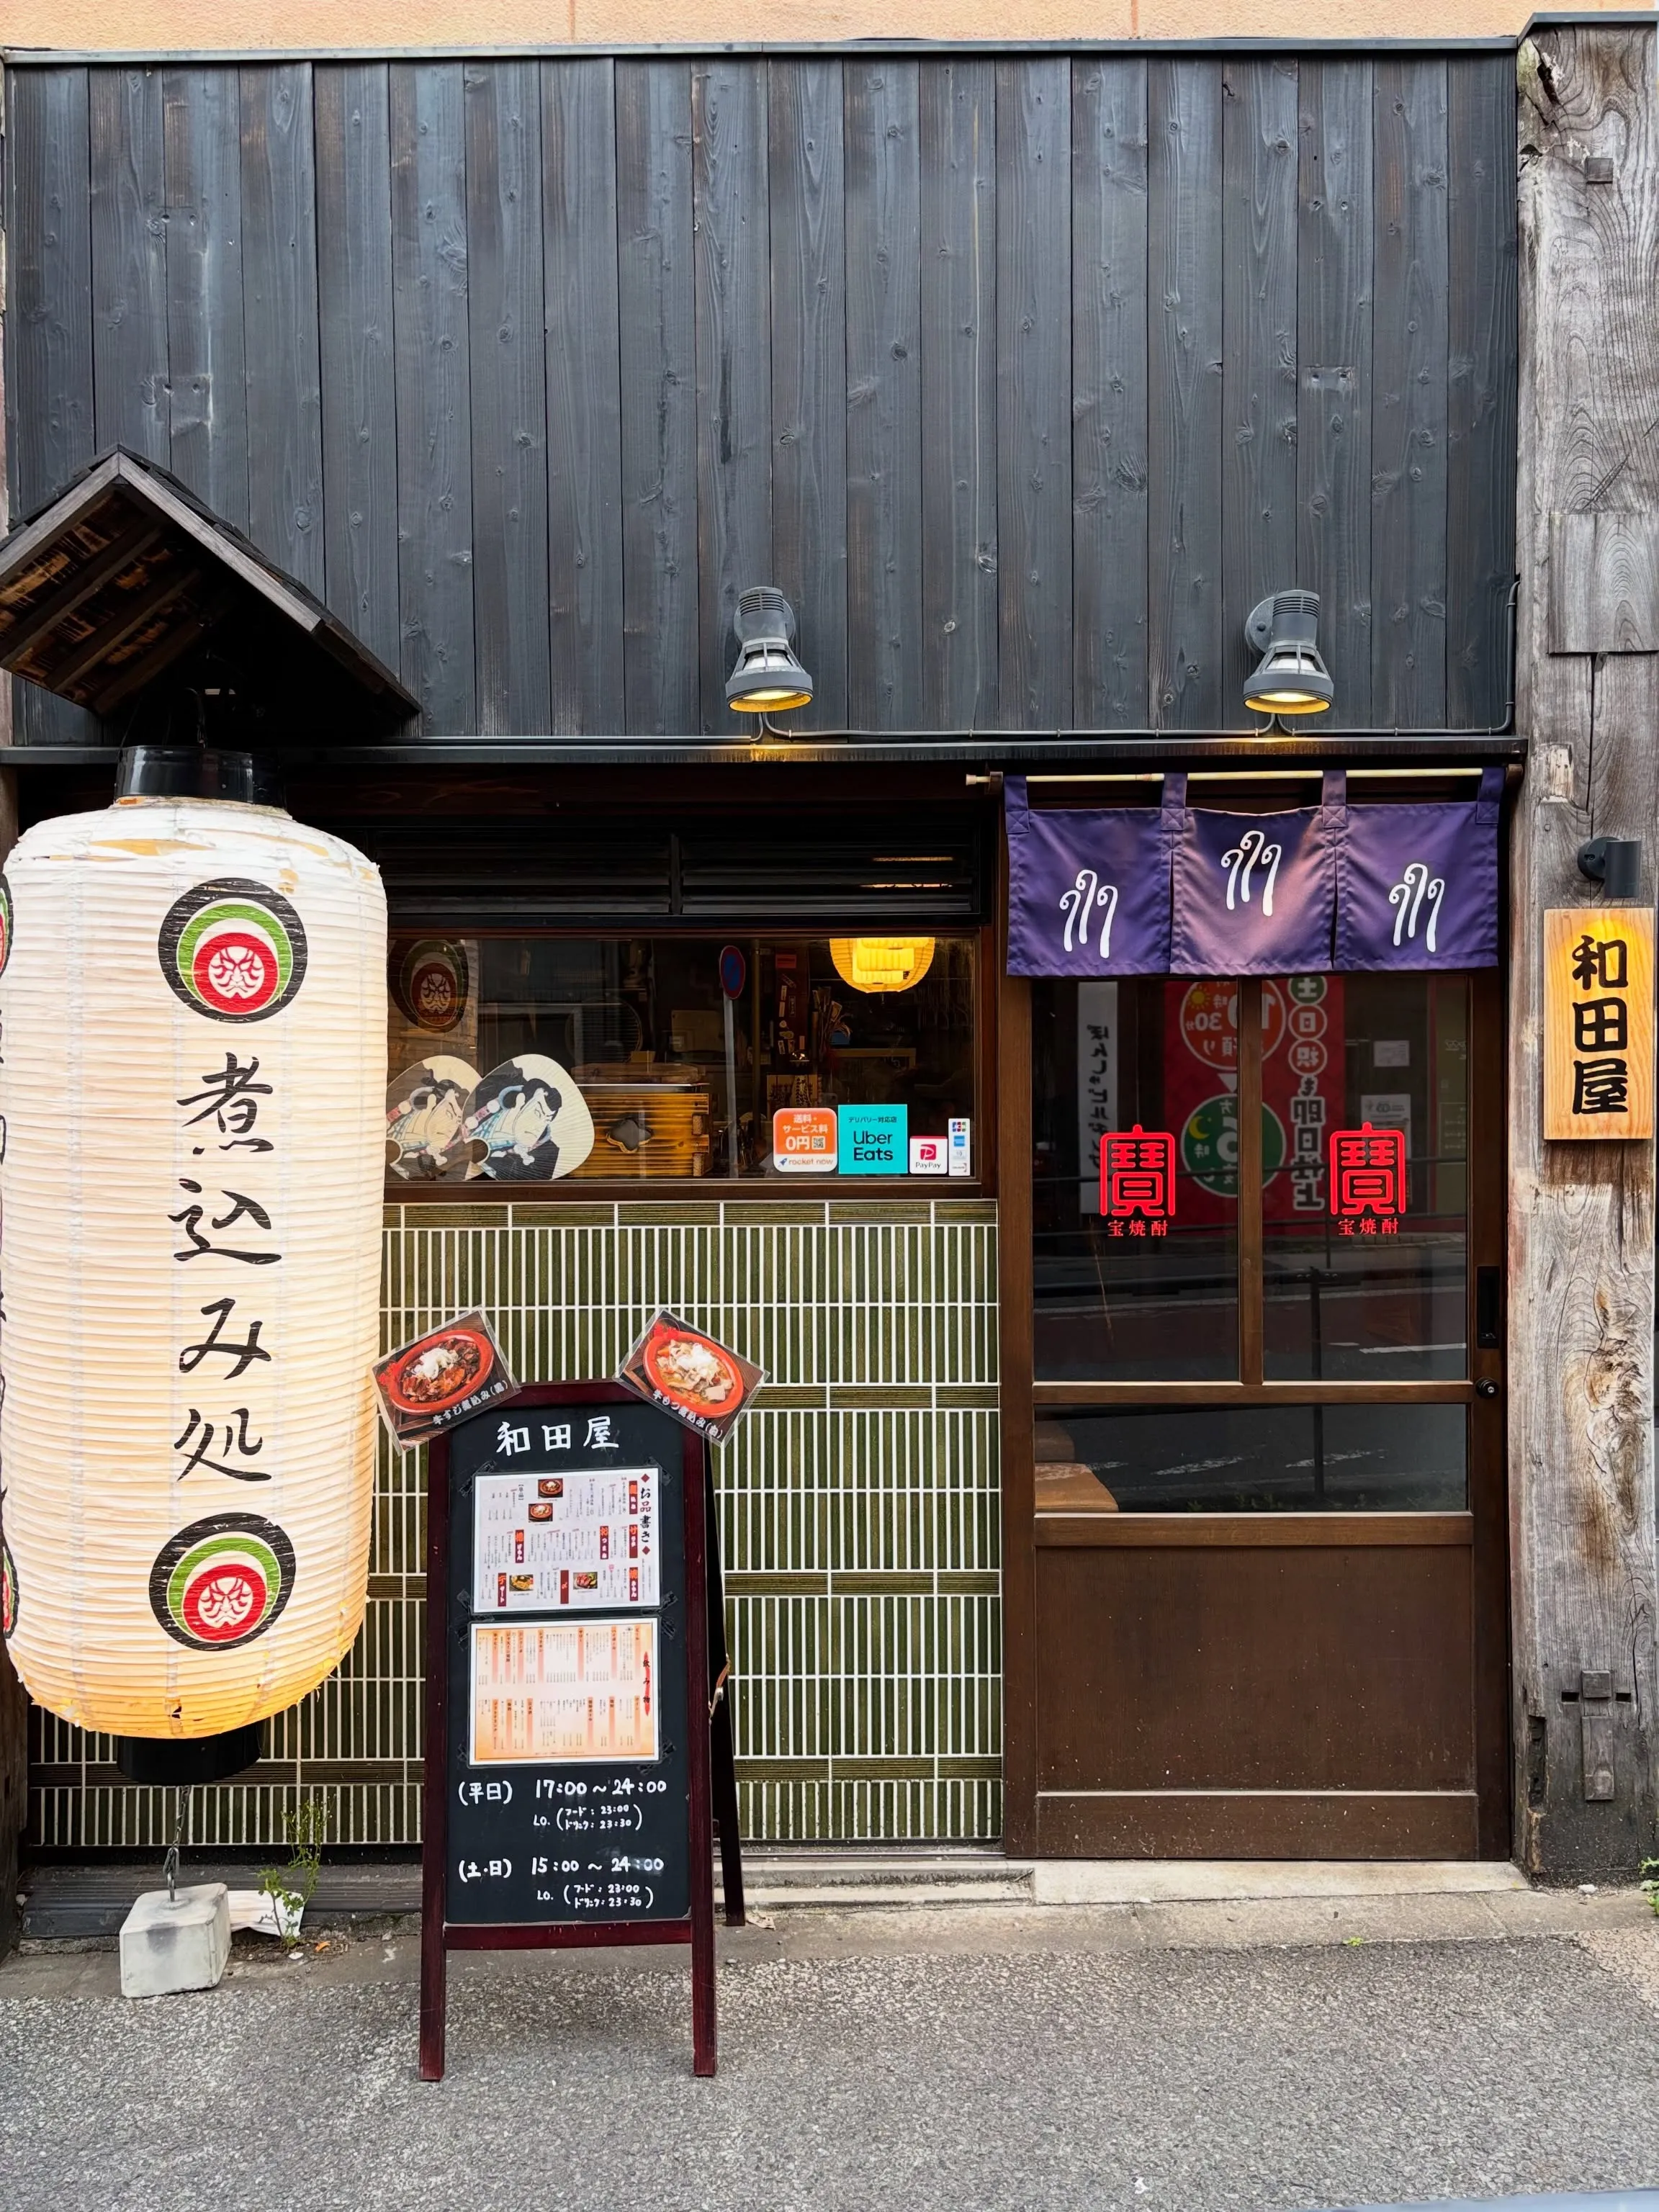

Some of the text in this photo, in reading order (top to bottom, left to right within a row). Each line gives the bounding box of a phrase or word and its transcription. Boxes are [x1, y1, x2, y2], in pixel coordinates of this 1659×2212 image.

[1570, 934, 1629, 1115] 和田屋
[783, 1124, 828, 1133] サービス料
[853, 1130, 893, 1145] Uber
[786, 1136, 810, 1151] 0円
[853, 1147, 894, 1161] Eats
[1107, 1220, 1169, 1237] 宝焼酎
[1337, 1218, 1399, 1236] 宝焼酎
[167, 1051, 283, 1482] 煮込み処
[496, 1416, 619, 1457] 和田屋
[639, 1487, 652, 1543] お品書き
[458, 1780, 513, 1806] (平日)
